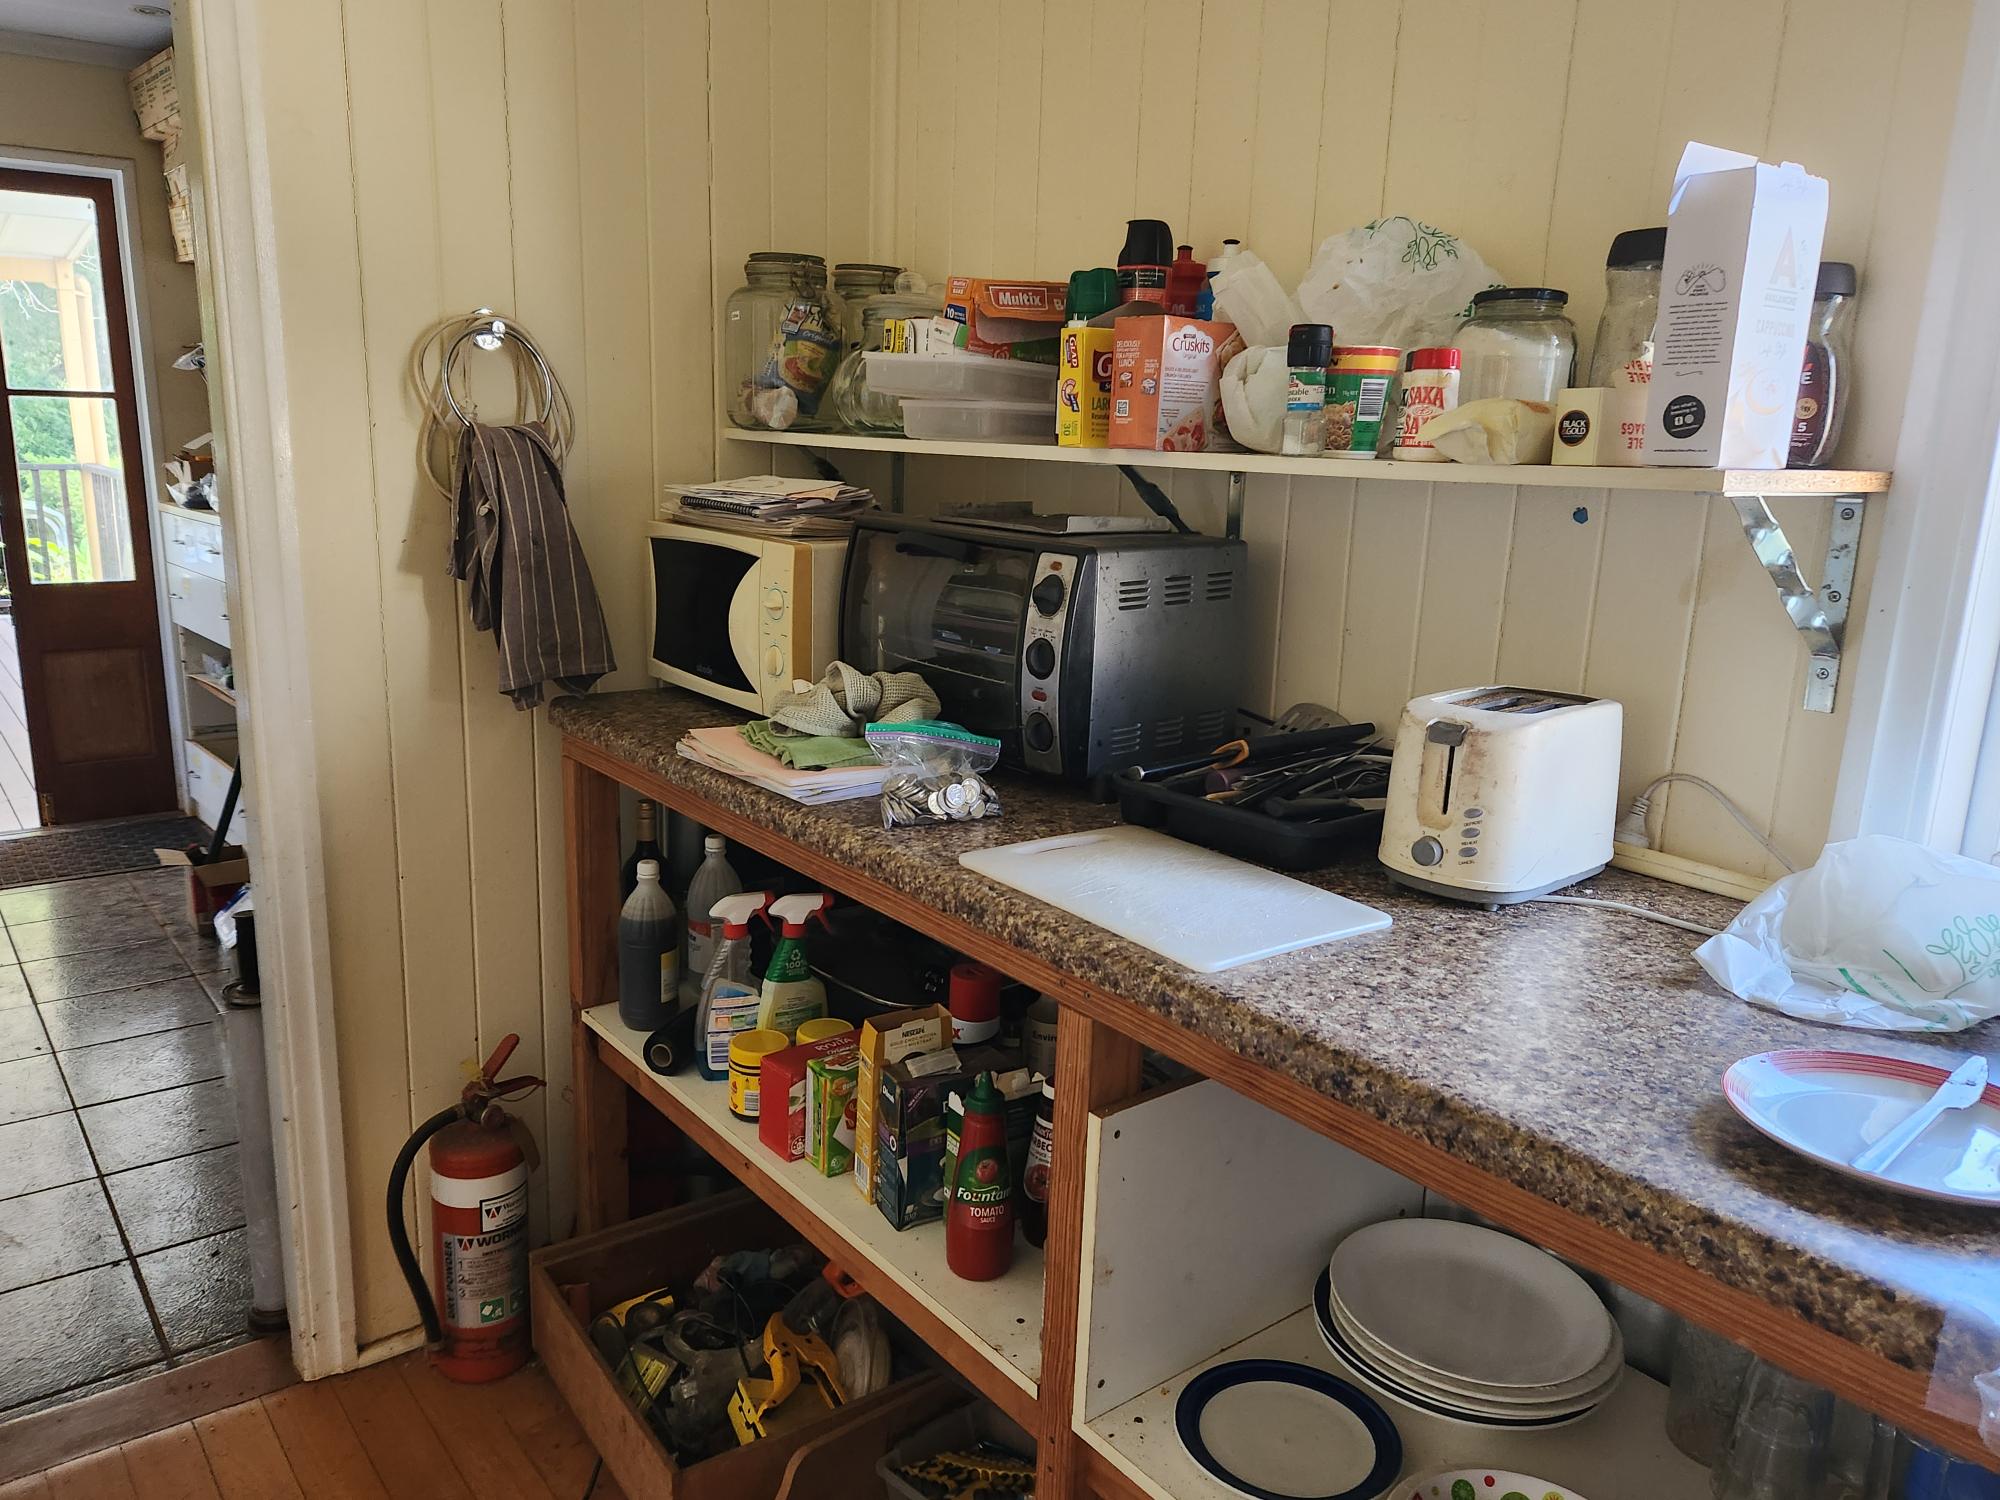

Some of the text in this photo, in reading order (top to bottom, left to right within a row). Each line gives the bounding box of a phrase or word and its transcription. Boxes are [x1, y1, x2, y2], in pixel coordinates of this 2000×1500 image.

[998, 292, 1042, 306] Multix
[947, 307, 955, 319] 10
[1069, 336, 1078, 368] GLAD
[1172, 337, 1210, 354] Cruskits
[1408, 386, 1445, 410] SAXA
[1563, 420, 1586, 428] BLACK
[814, 1037, 854, 1051] RYVITA
[969, 1205, 1005, 1217] TOMATO
[444, 1240, 453, 1292] POWDER
